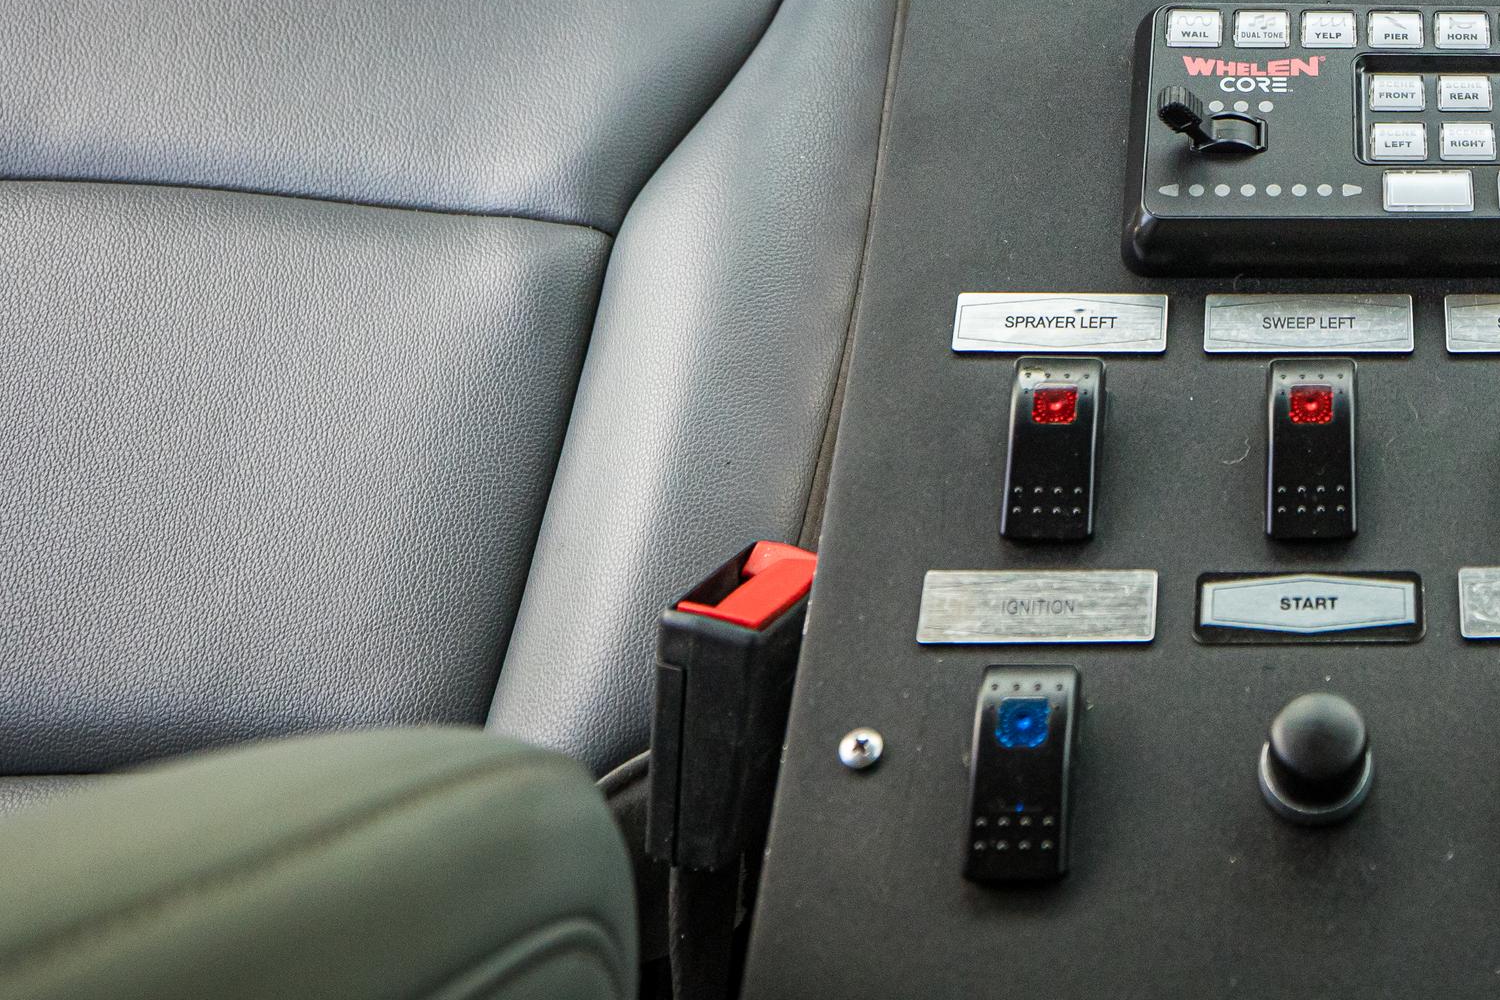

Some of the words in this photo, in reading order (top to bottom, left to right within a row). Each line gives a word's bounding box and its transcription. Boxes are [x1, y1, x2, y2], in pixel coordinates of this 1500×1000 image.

[1241, 31, 1261, 39] DUAL
[1264, 31, 1284, 39] TONE
[1315, 32, 1342, 40] YELP
[1183, 56, 1319, 77] WHELEN
[1219, 77, 1288, 93] CORE
[1379, 91, 1416, 99] FRONT
[1450, 92, 1479, 100] REAR
[1450, 140, 1486, 148] RIGHT
[1004, 315, 1077, 329] SPRAYER
[1080, 315, 1118, 329] LEFT
[1262, 316, 1316, 330] SWEEP
[1319, 316, 1357, 329] LEFT
[1001, 598, 1075, 615] IGNITION
[1280, 596, 1339, 611] START
